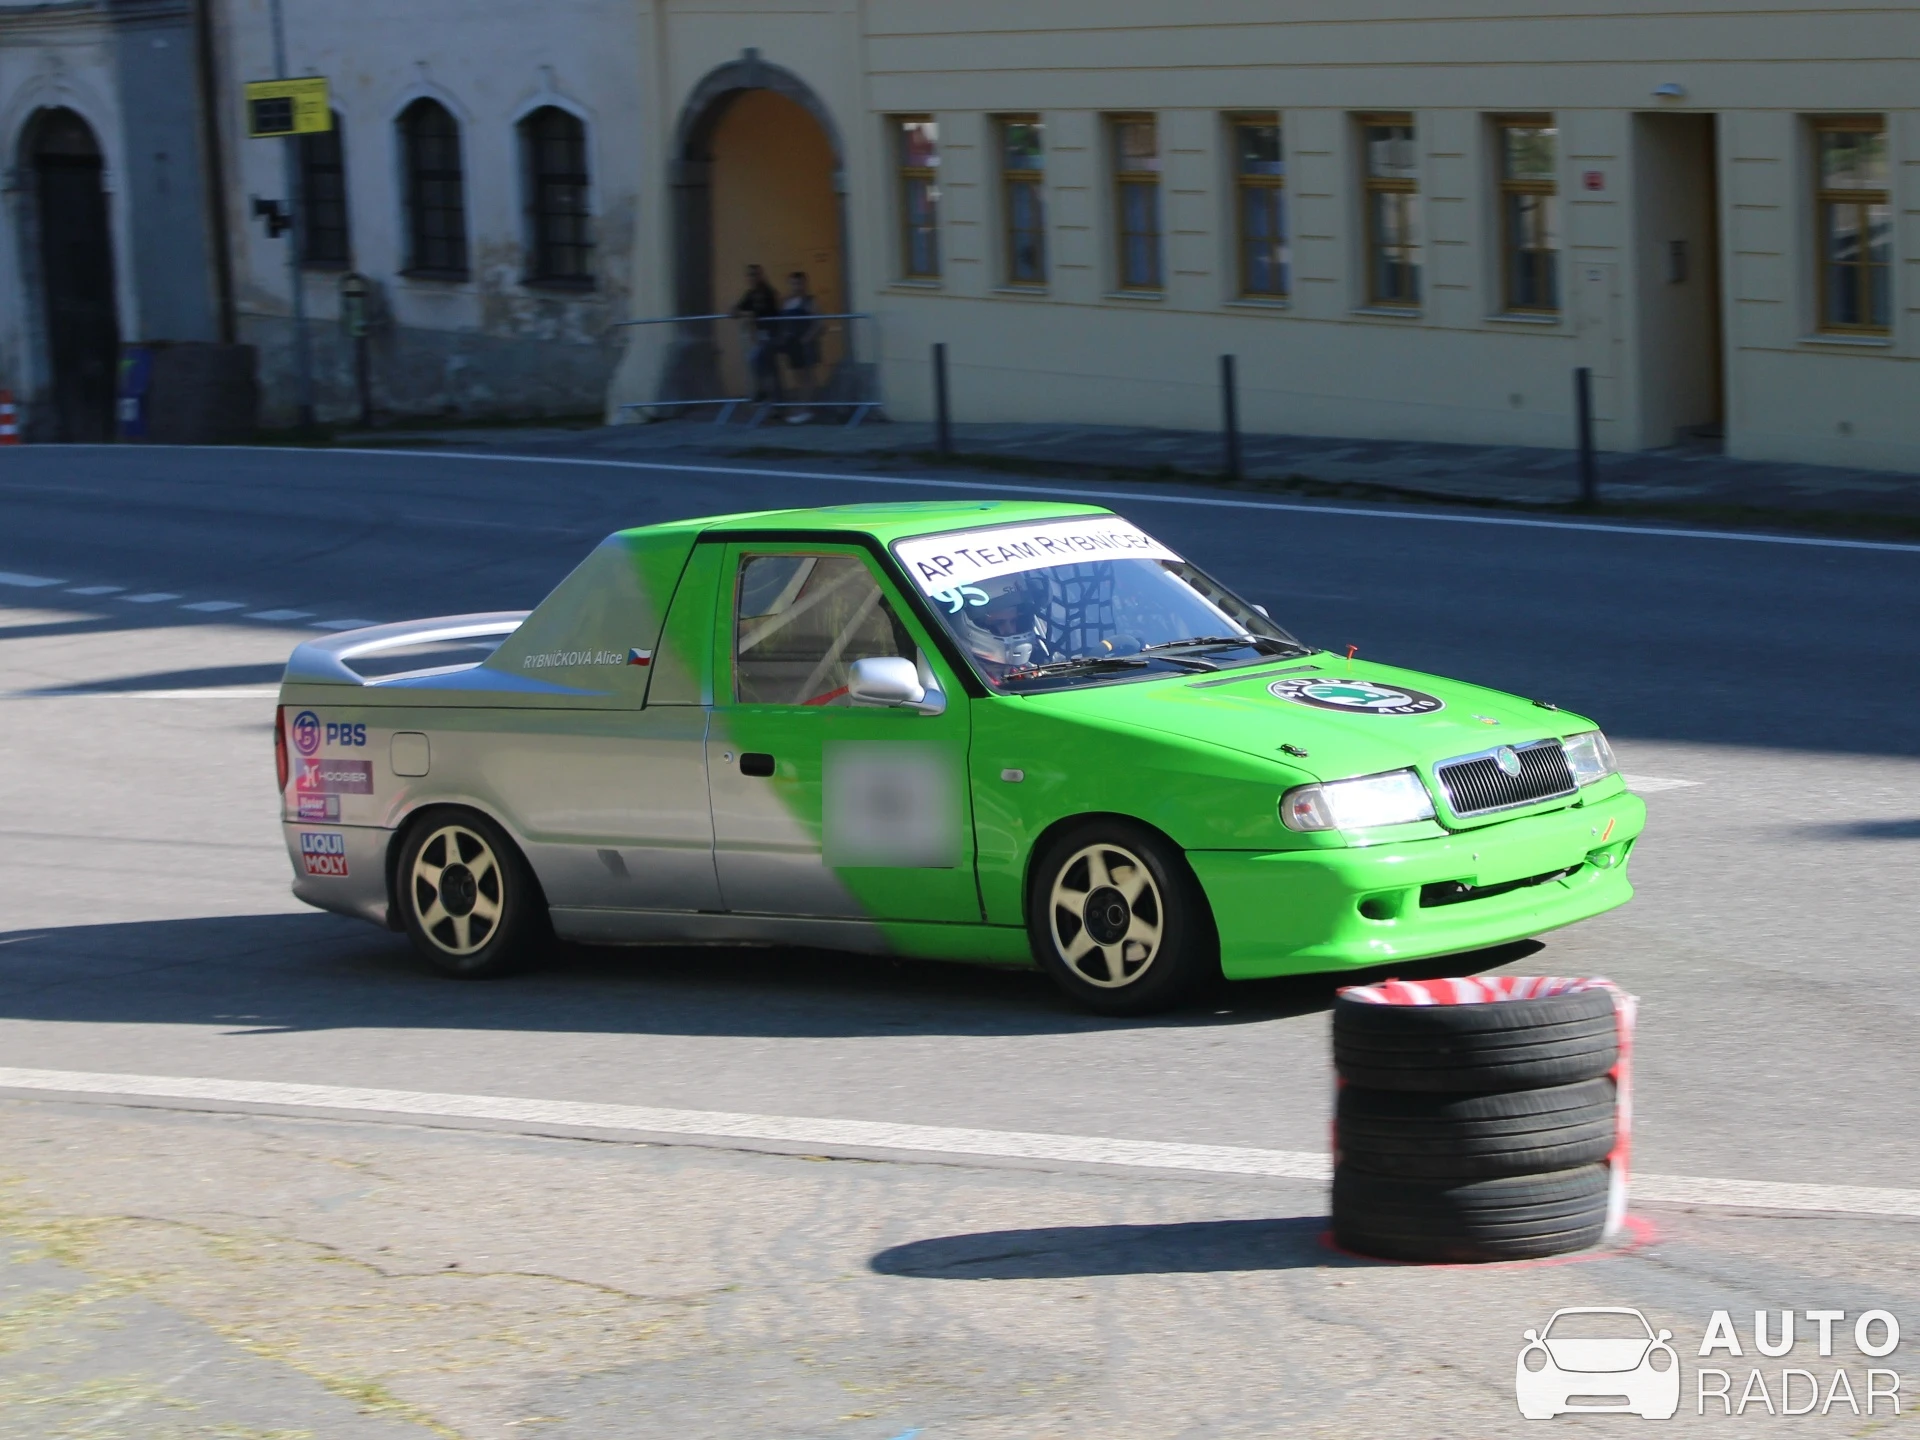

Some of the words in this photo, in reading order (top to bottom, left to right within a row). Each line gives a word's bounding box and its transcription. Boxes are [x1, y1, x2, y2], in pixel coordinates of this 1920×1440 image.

[917, 555, 954, 582] AP
[954, 540, 1041, 568] TEAM
[523, 649, 592, 668] RYBNÍČKOVÁ
[594, 651, 622, 665] Alice
[1377, 700, 1437, 714] AUTO
[326, 723, 366, 746] PBS
[302, 834, 343, 854] LIQUI
[305, 855, 345, 874] MOLY
